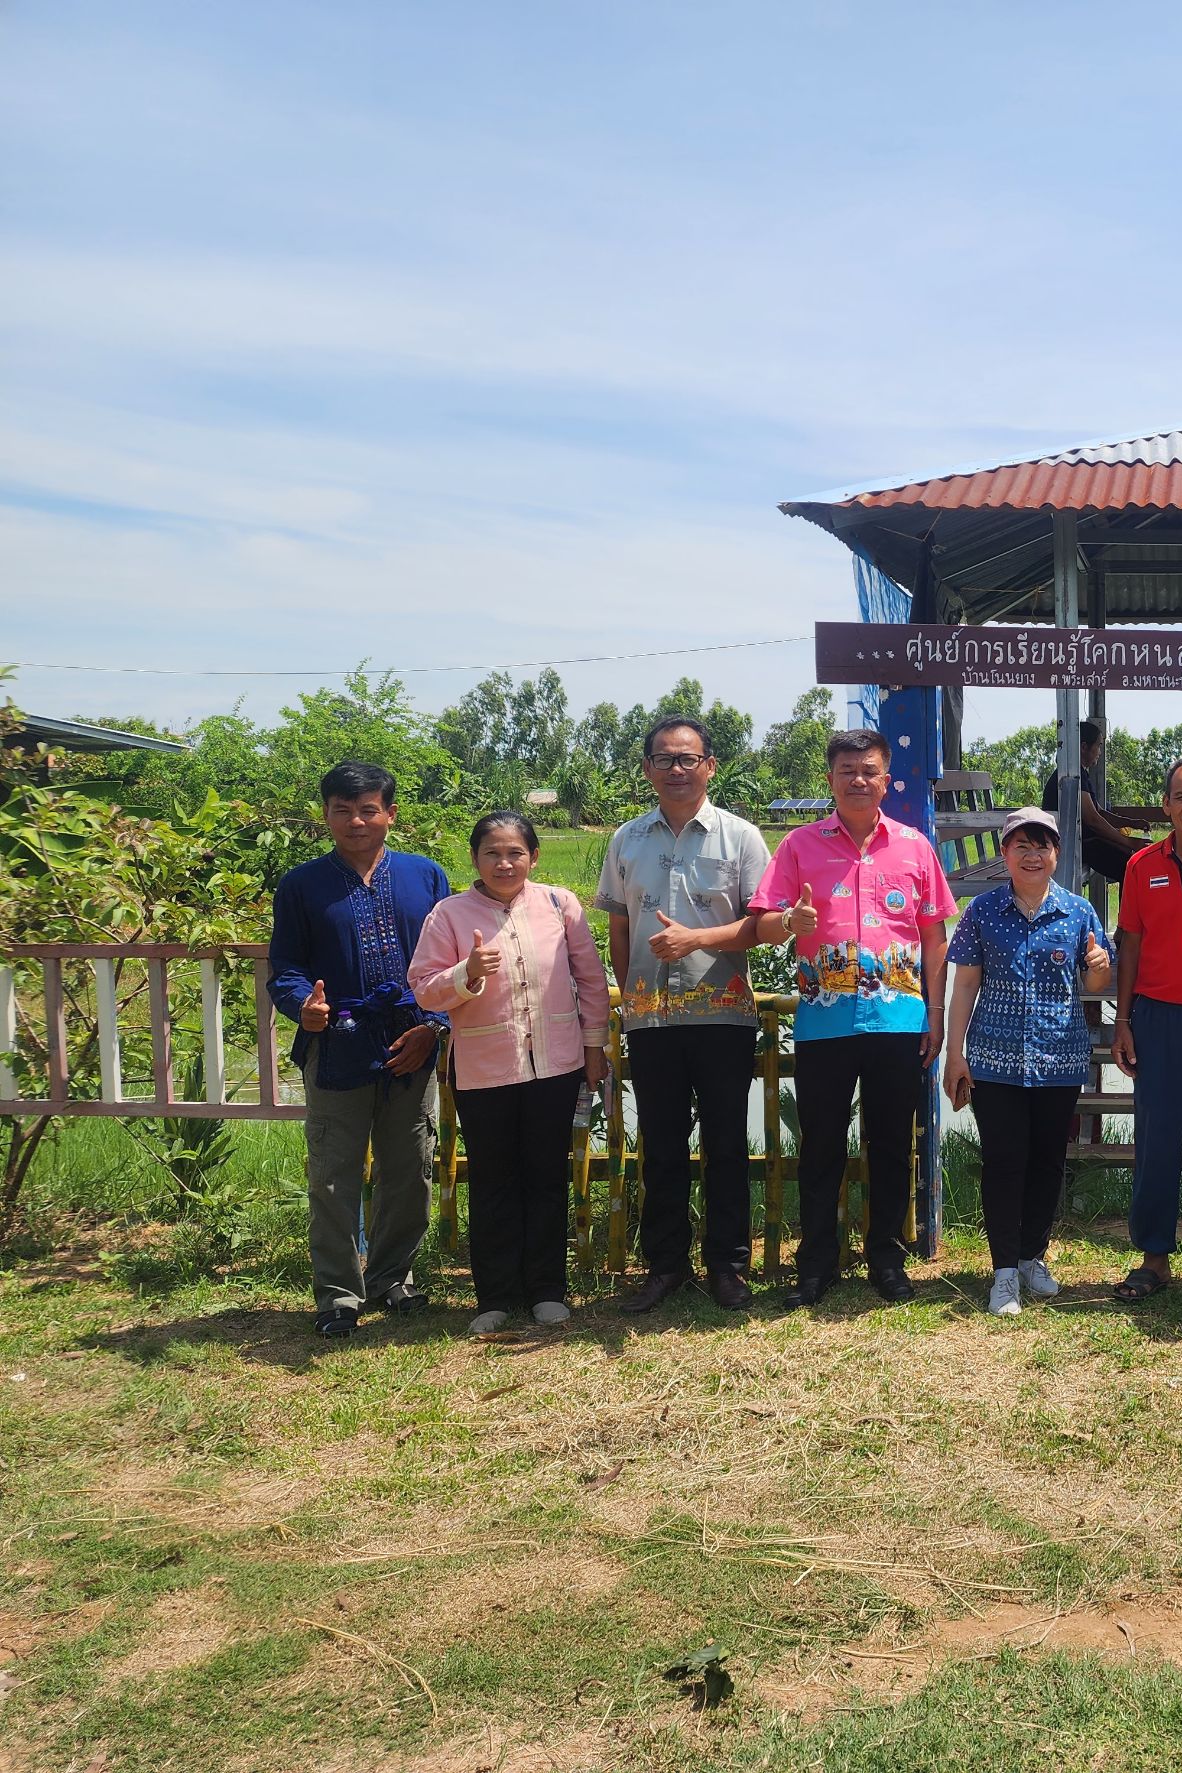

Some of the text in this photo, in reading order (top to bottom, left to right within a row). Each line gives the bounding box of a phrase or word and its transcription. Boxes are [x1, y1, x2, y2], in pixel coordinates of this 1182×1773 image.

[961, 665, 1036, 685] บ้านโนนยาง
[1049, 668, 1109, 687] ต.พระเสาร์
